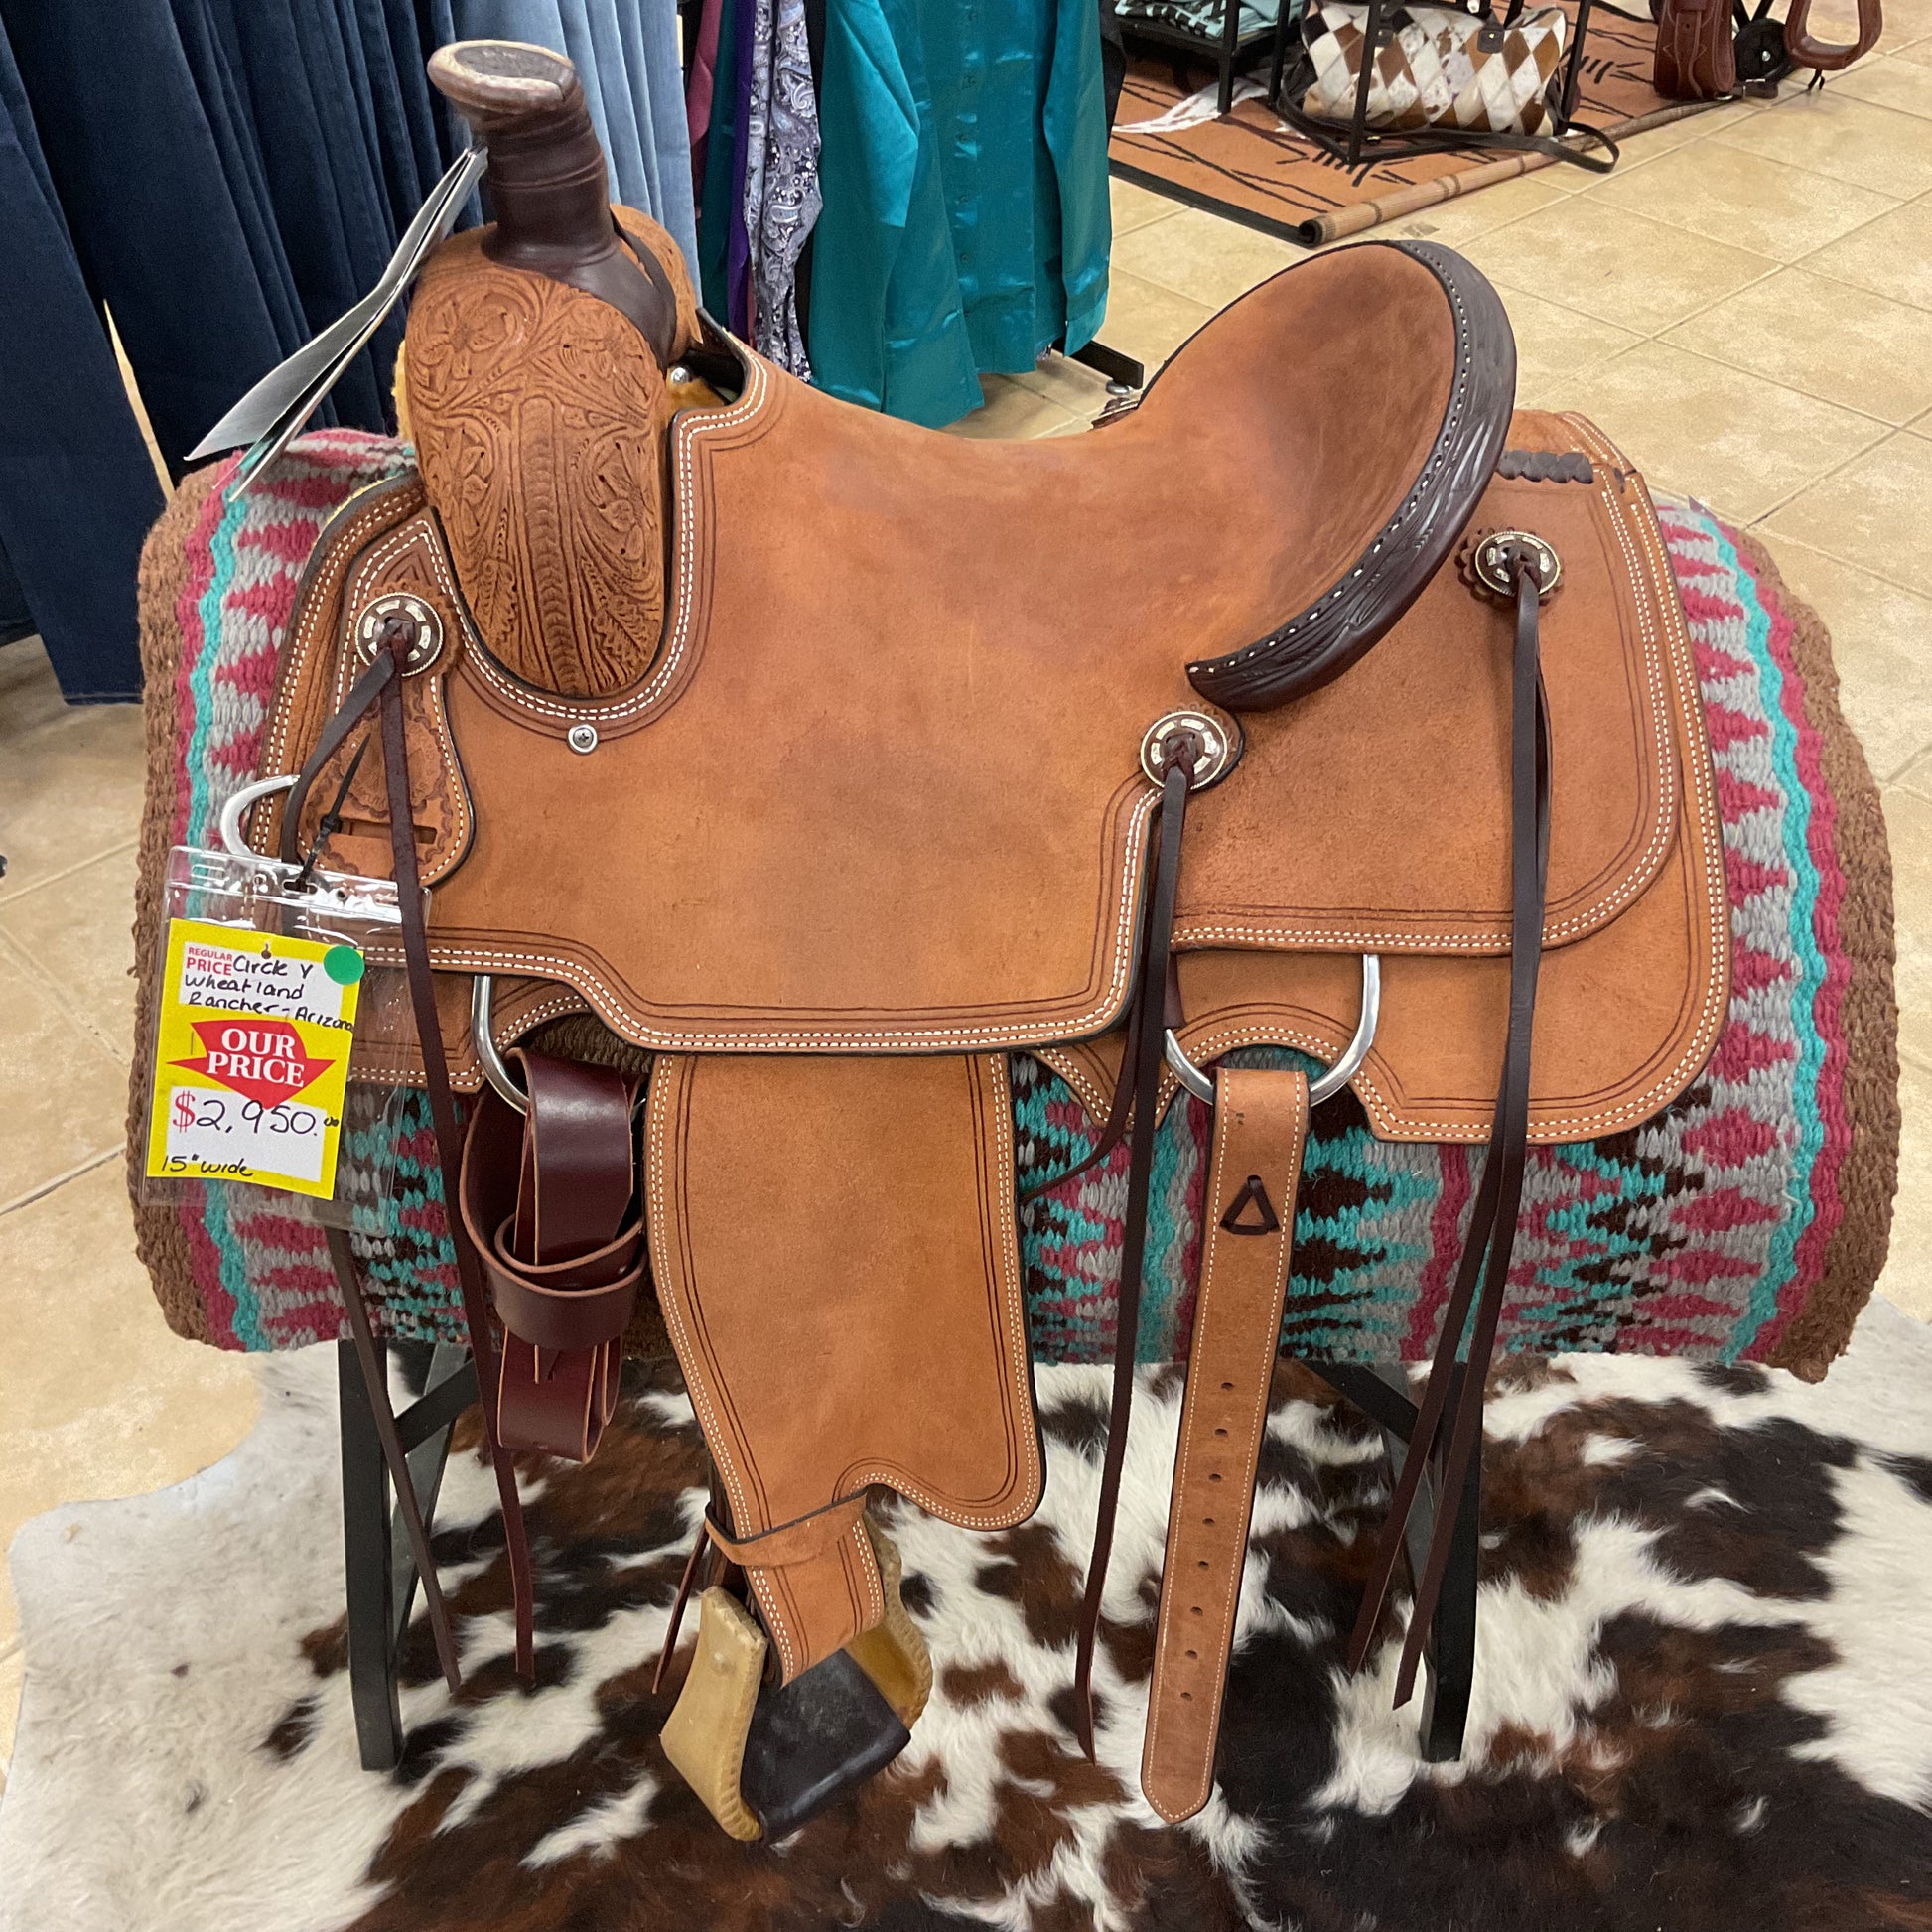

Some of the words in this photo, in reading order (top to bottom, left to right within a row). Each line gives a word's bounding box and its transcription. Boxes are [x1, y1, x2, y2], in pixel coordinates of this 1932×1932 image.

[189, 947, 233, 962] REGULAR
[187, 958, 232, 976] PRICE
[222, 1029, 296, 1059] OUR
[207, 1051, 304, 1087] PRICE
